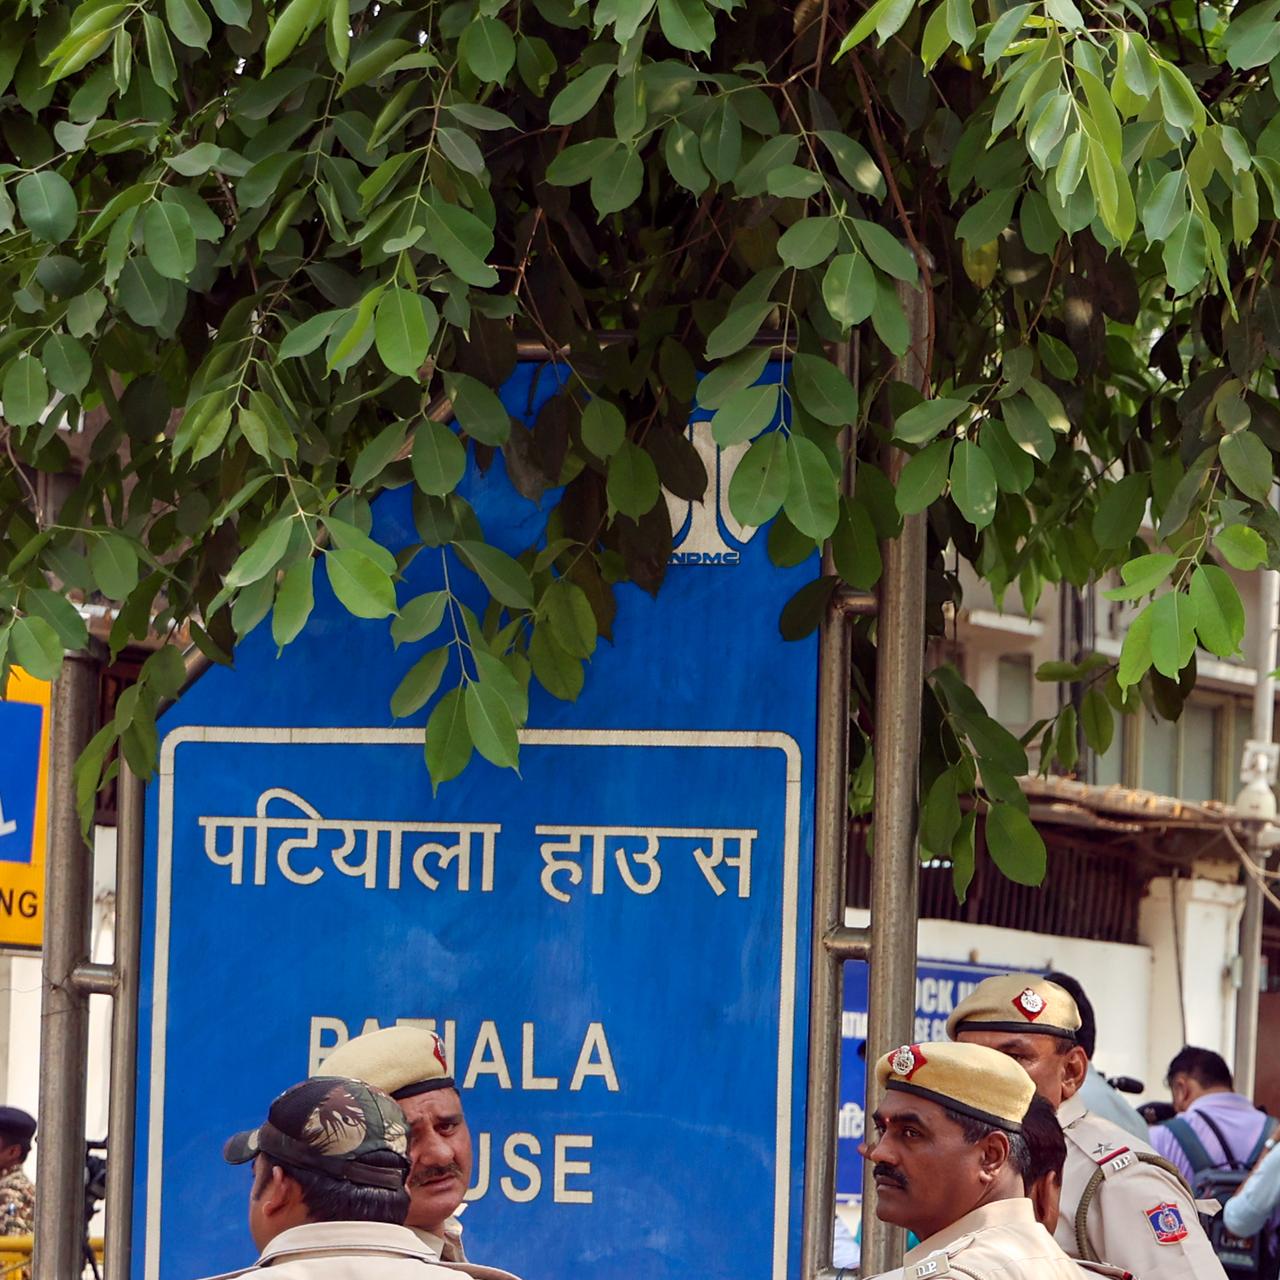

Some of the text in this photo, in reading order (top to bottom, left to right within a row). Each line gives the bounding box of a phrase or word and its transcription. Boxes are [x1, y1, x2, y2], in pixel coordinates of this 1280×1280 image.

[669, 551, 740, 565] NDMC
[198, 787, 759, 903] पटियाला हाउस
[309, 1016, 620, 1092] PIALA
